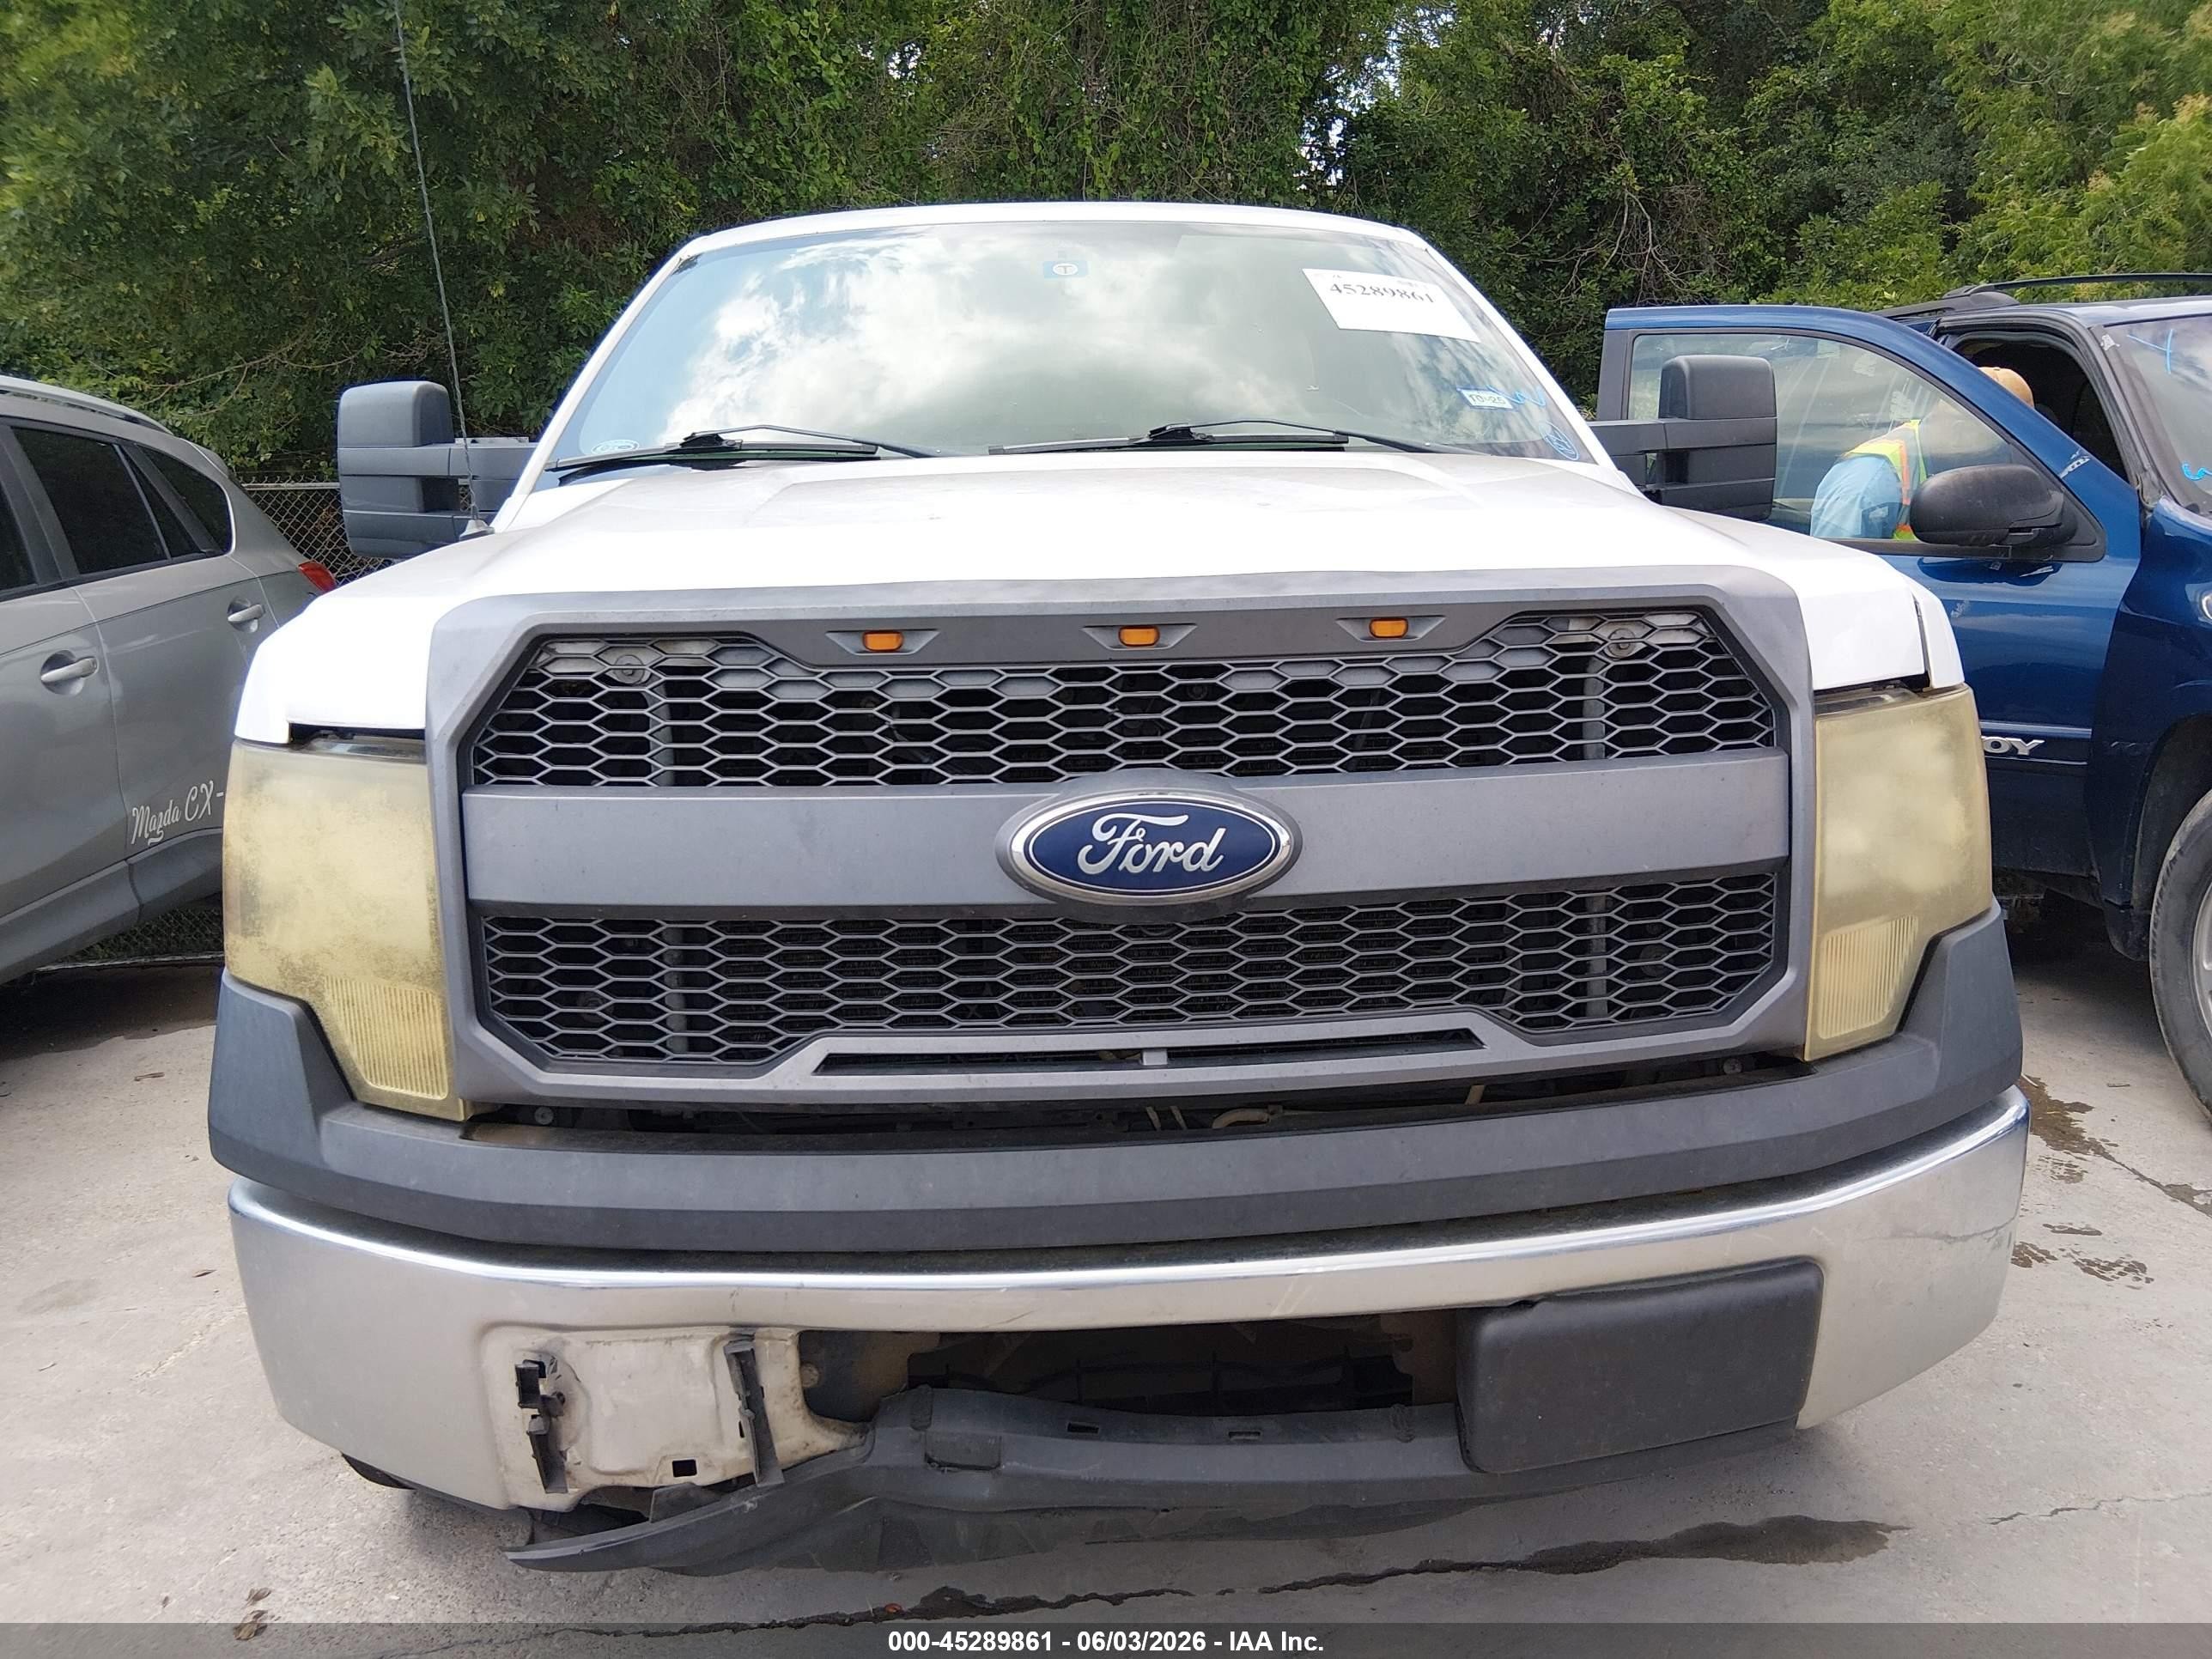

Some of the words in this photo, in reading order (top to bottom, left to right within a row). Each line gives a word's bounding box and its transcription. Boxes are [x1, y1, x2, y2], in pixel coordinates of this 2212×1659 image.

[1329, 283, 1435, 303] 45289861
[1981, 736, 2045, 756] OY
[131, 799, 182, 846] Mazda
[185, 780, 224, 822] CX-
[1077, 812, 1226, 874] Ford
